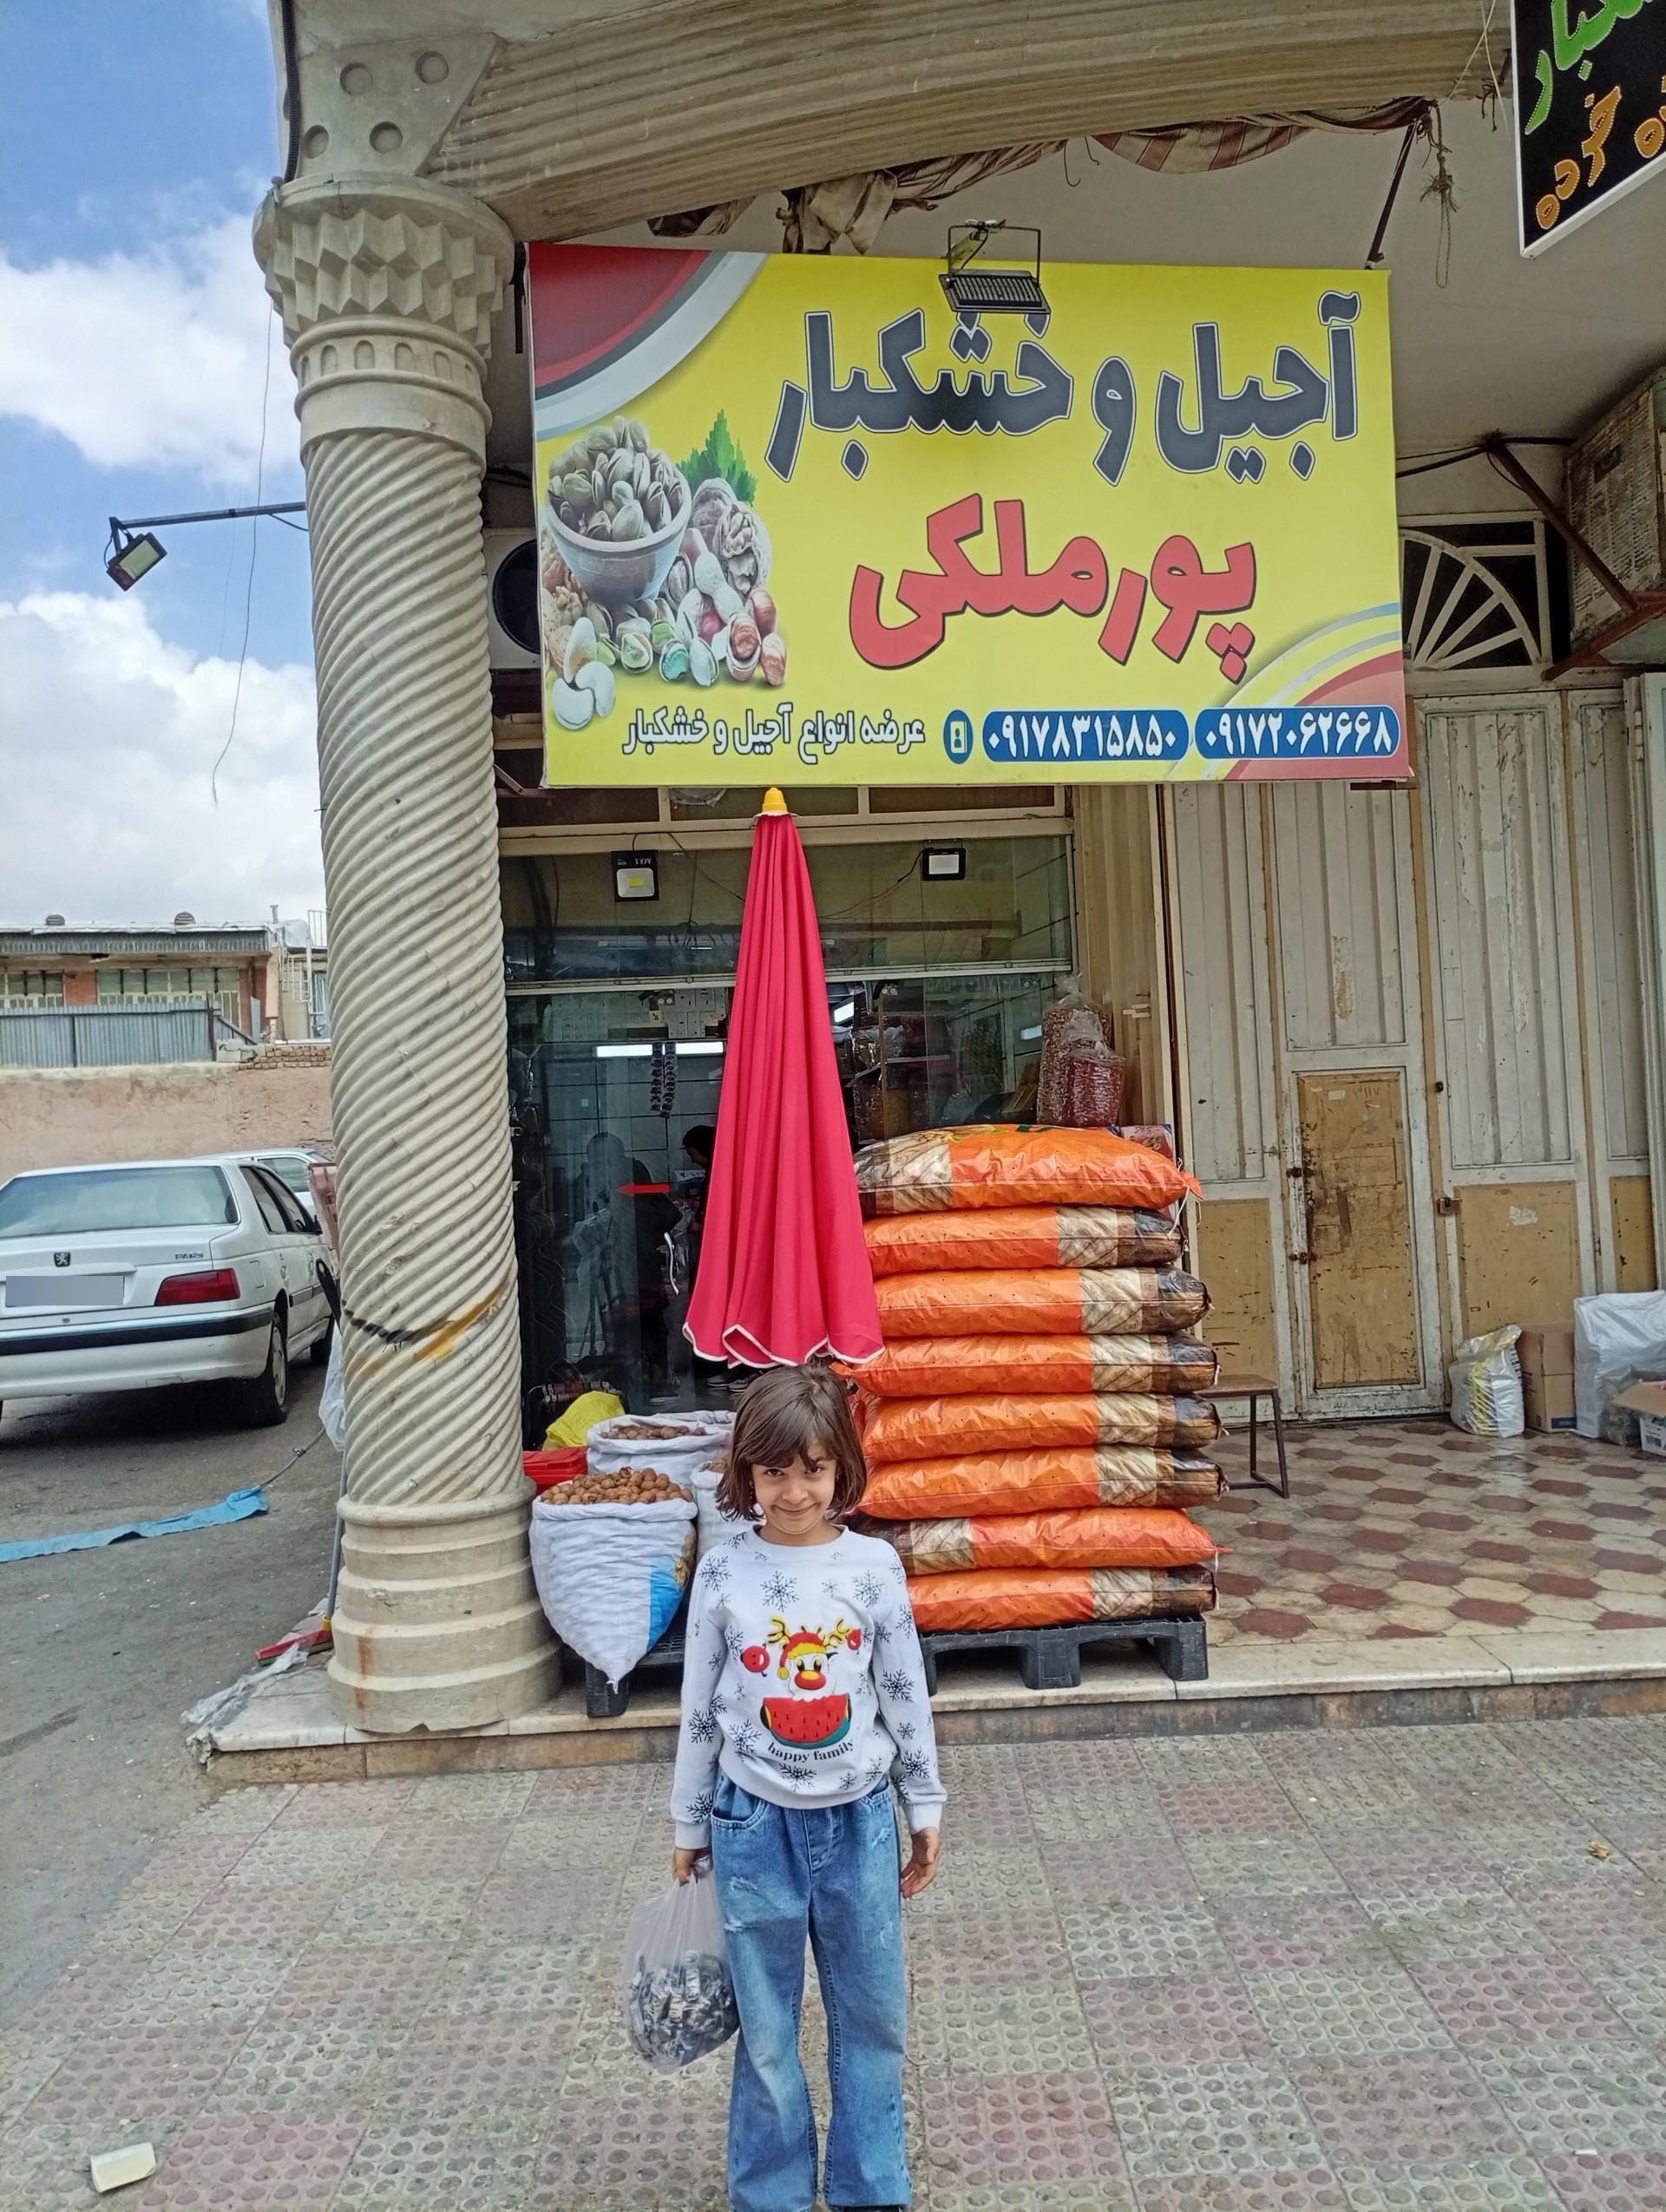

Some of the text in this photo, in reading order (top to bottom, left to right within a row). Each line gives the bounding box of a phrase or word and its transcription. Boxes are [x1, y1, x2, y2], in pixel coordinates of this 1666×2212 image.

[764, 291, 1362, 486] آجیل و خشکبار
[622, 702, 926, 765] عرضه انواع آجیل و خشکبار
[767, 1738, 854, 1764] happy family
